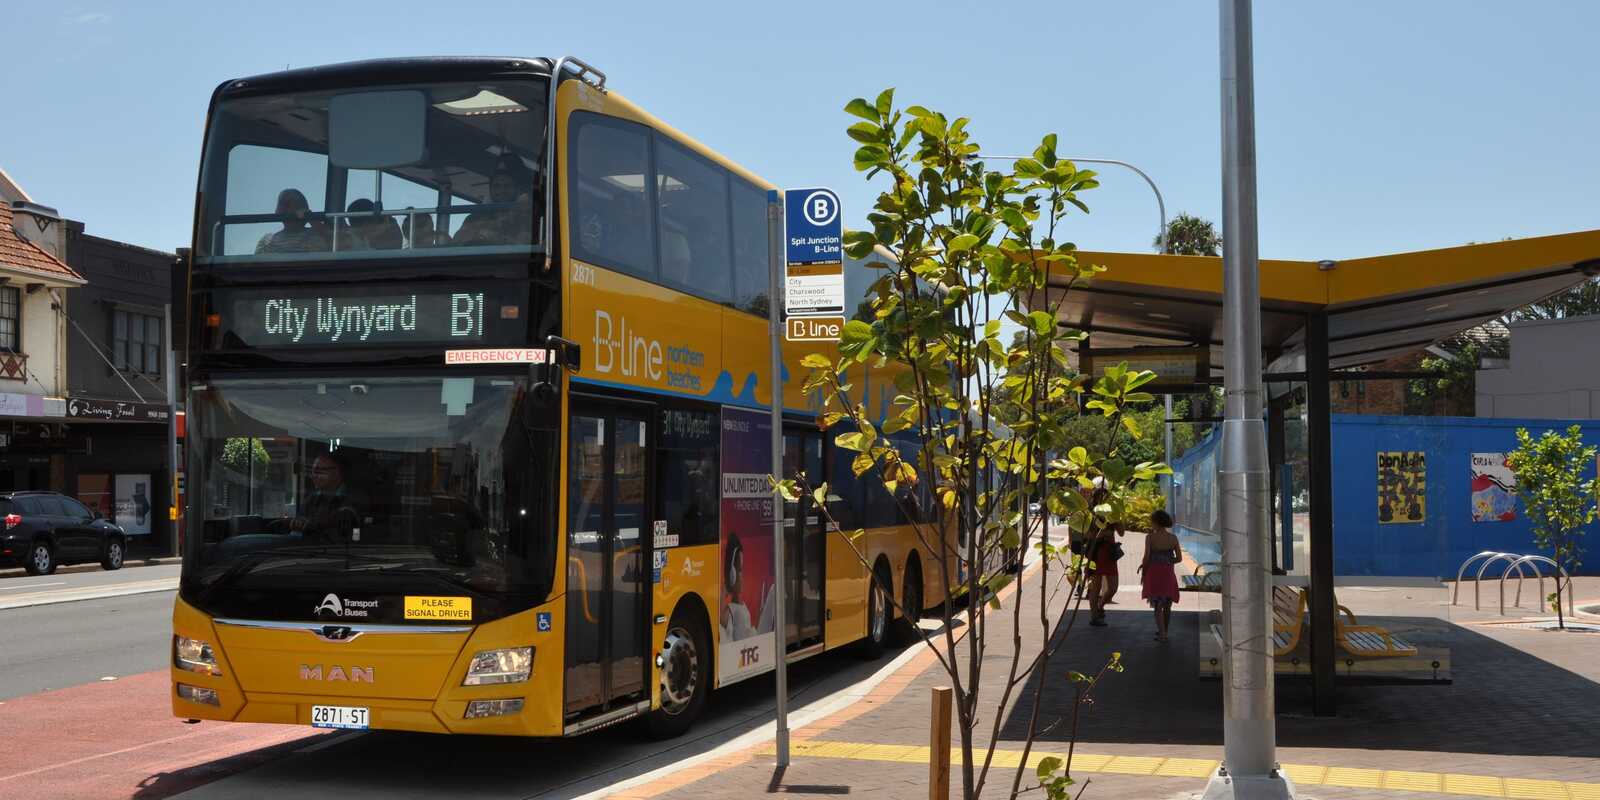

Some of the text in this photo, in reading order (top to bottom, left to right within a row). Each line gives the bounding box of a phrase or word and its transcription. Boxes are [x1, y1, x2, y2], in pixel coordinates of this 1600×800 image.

[814, 199, 828, 219] B
[791, 236, 839, 247] Spit Junction
[814, 244, 840, 253] B-Line
[573, 263, 595, 287] 2871
[789, 278, 802, 288] City
[789, 297, 833, 306] North Sydney
[265, 294, 417, 342] City Wynyard
[451, 292, 484, 337] B1
[447, 350, 546, 362] EMERGENCY EXI
[667, 345, 705, 368] northern
[667, 369, 704, 391] beaches
[82, 401, 113, 419] Living
[724, 477, 758, 494] UNLIMITED
[344, 598, 378, 609] Transport
[421, 599, 454, 607] PLEASE
[344, 608, 368, 617] Buses
[407, 609, 470, 618] SIGNAL DRIVER
[299, 663, 375, 684] MAN
